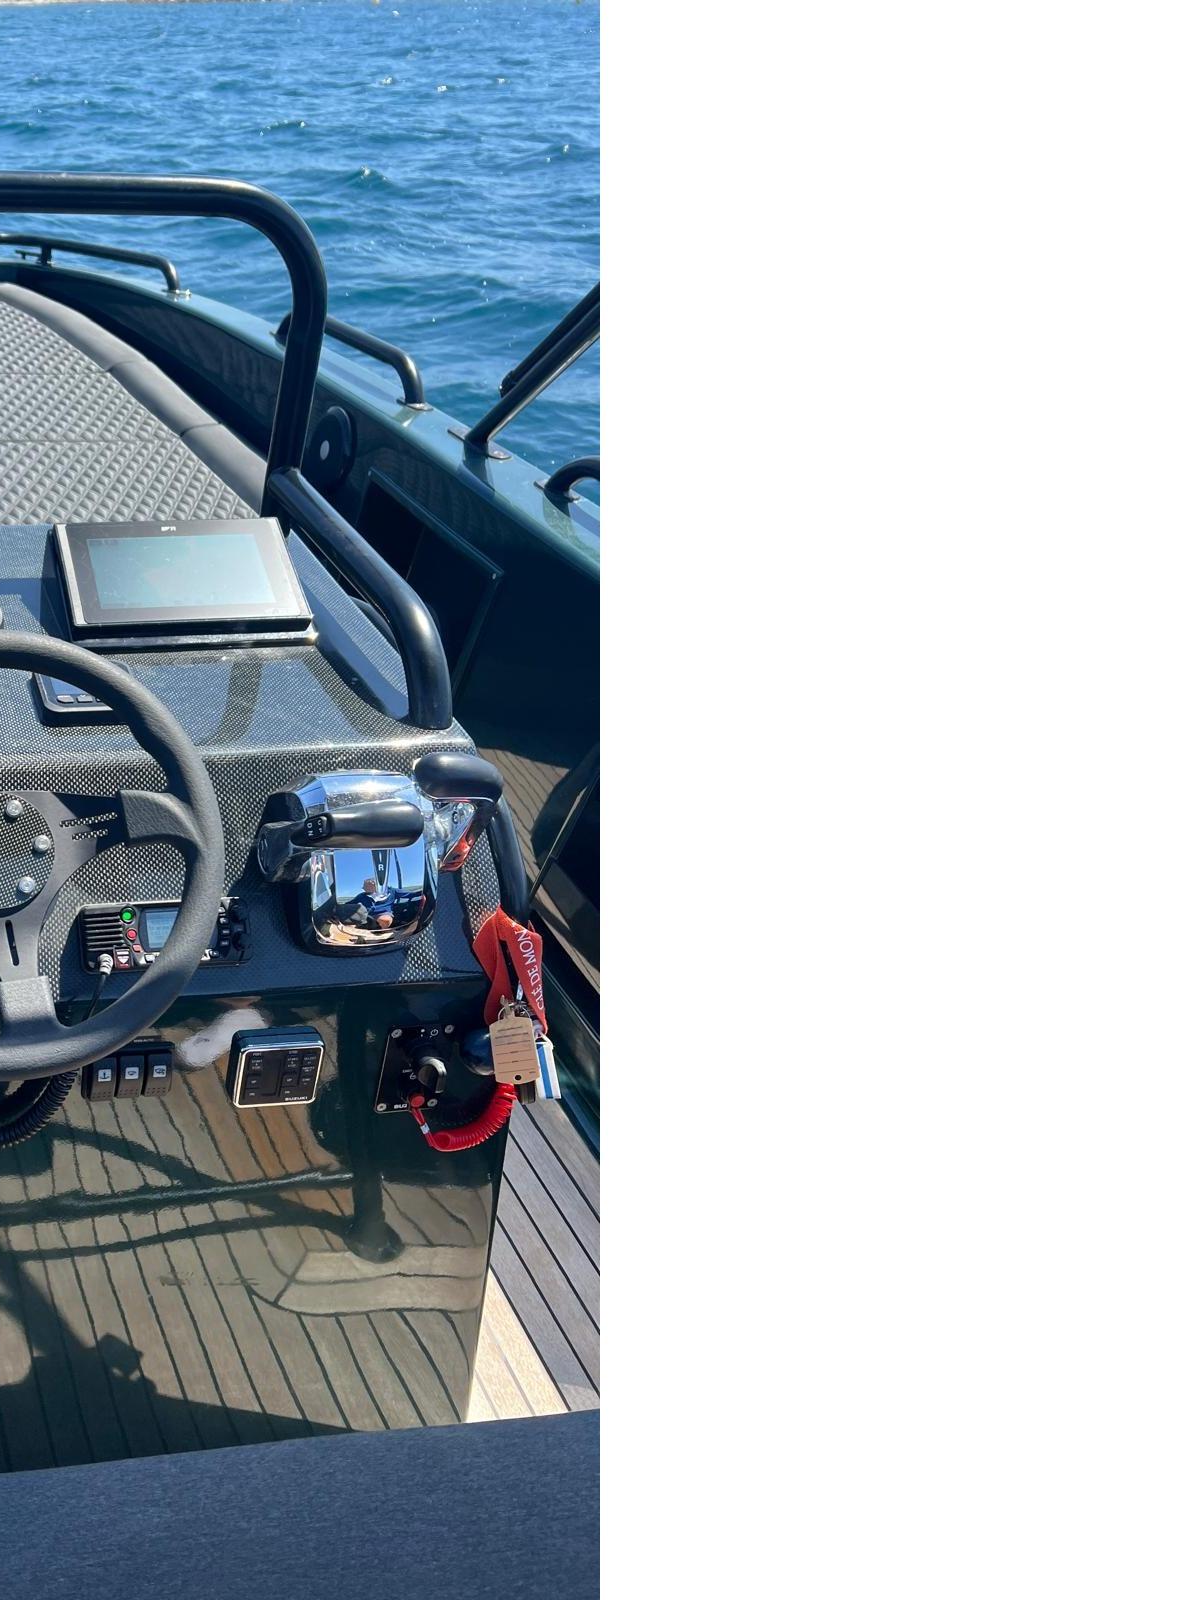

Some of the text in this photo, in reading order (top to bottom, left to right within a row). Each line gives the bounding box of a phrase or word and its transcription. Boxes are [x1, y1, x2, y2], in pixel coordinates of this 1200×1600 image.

[378, 863, 384, 871] R
[514, 929, 537, 966] MON
[527, 966, 541, 986] DE
